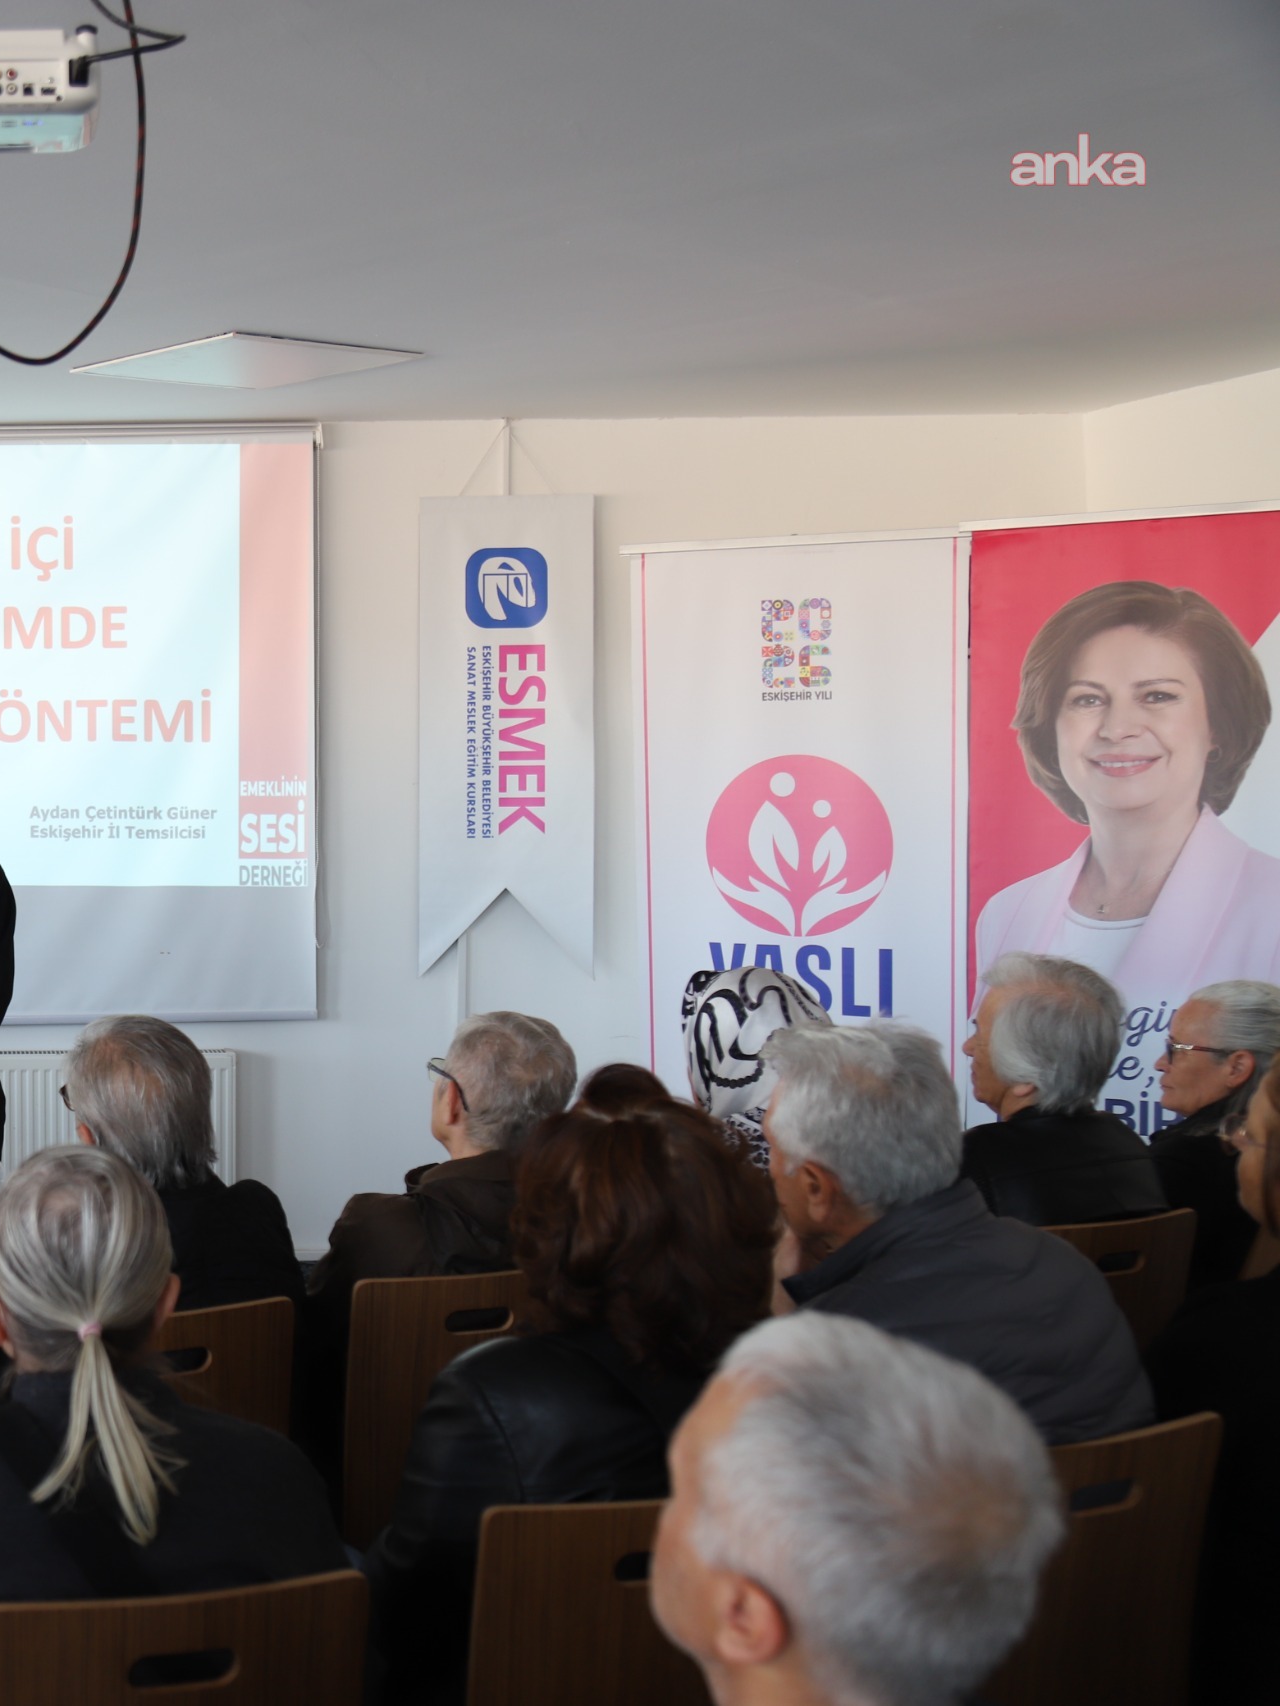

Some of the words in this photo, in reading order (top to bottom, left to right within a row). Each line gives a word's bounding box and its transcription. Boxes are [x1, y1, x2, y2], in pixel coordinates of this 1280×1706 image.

[10, 515, 75, 581] İÇİ
[467, 646, 476, 686] SANAT
[480, 645, 494, 701] ESKİŞEHİR
[467, 690, 476, 734] MESLEK
[762, 690, 812, 702] ESKİŞEHİR
[815, 690, 832, 700] YILI
[467, 738, 478, 778] EĞİTİM
[480, 705, 494, 776] BÜYÜKŞEHİR
[498, 644, 547, 836] ESMEK
[240, 776, 307, 797] EMEKLİNİN
[29, 805, 80, 822] Aydan
[85, 805, 163, 822] Çetintürk
[167, 806, 218, 820] Güner
[240, 800, 305, 853] SESİ
[467, 782, 476, 839] KURSLARI
[481, 779, 494, 839] BELEDİYESİ
[29, 825, 104, 841] Eskişehir
[107, 823, 120, 839] İl
[125, 825, 206, 839] Temsilcisi
[239, 860, 308, 886] DERNEĞİ
